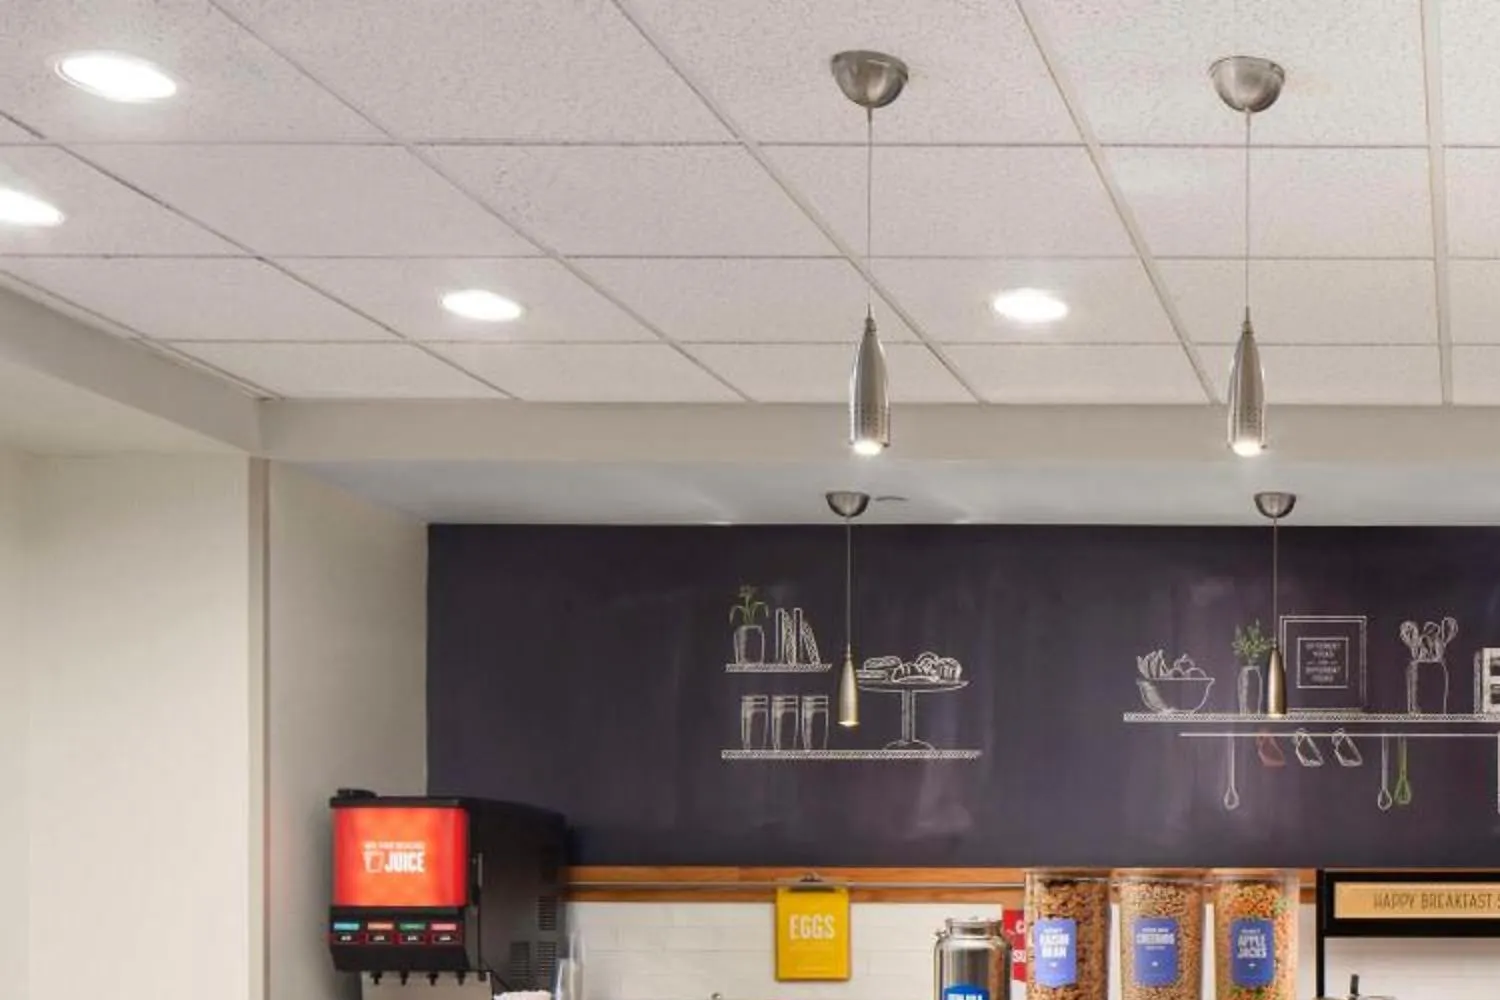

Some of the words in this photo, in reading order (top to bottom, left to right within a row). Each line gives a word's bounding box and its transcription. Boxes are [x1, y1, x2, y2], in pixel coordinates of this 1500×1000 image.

[384, 851, 425, 874] JUICE
[1373, 892, 1415, 910] HAPPY
[1421, 892, 1491, 910] BREAKFAST
[789, 912, 836, 940] EGGS
[1238, 935, 1266, 947] APPLE
